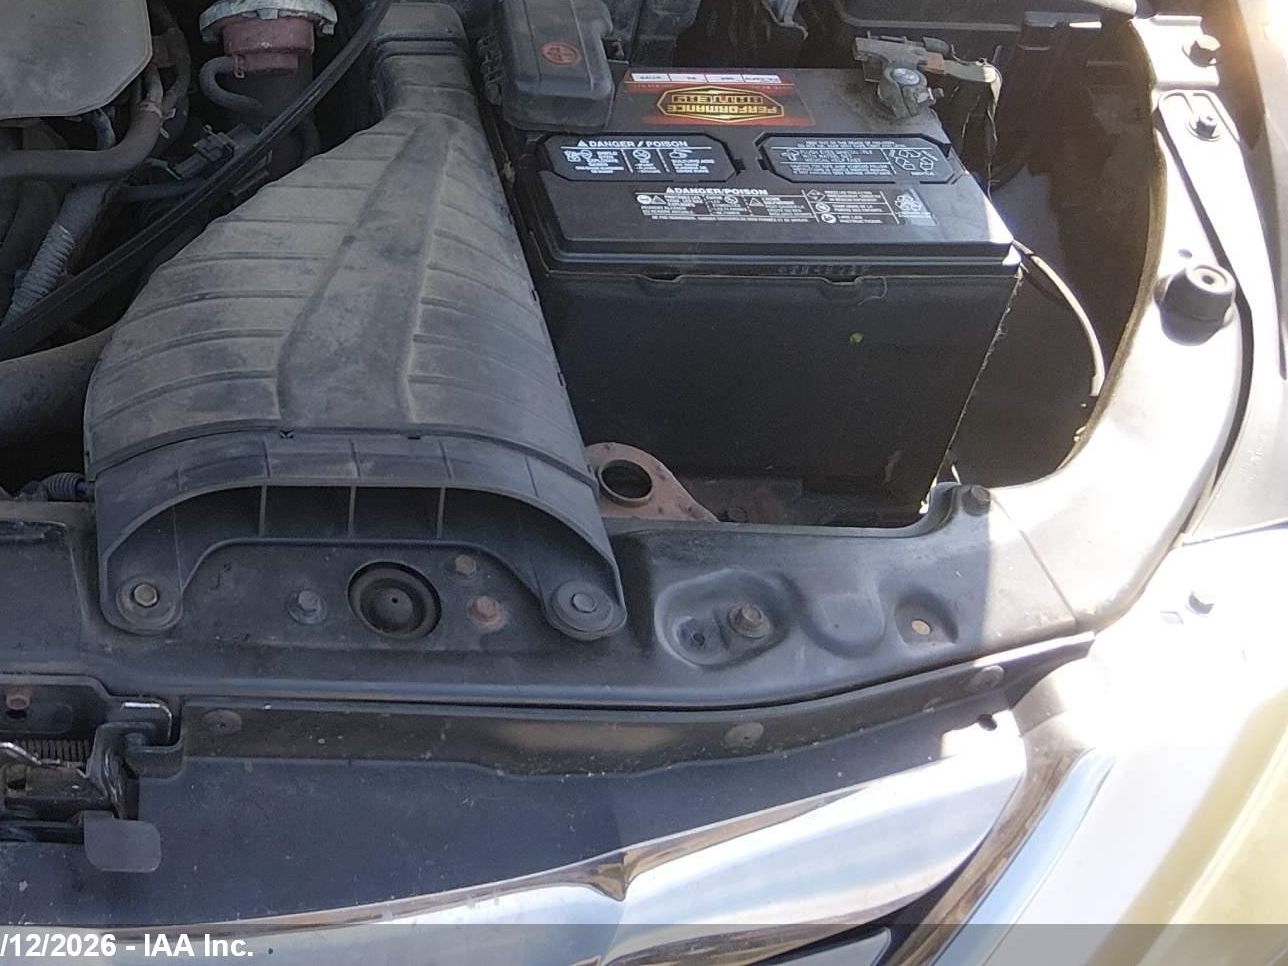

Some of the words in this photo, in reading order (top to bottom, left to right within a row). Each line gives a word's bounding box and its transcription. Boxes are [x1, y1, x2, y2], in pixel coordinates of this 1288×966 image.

[666, 104, 779, 115] PERFORMANCE
[588, 140, 636, 148] DANGER
[645, 140, 688, 148] POISON
[675, 187, 768, 196] DANGER/POISON
